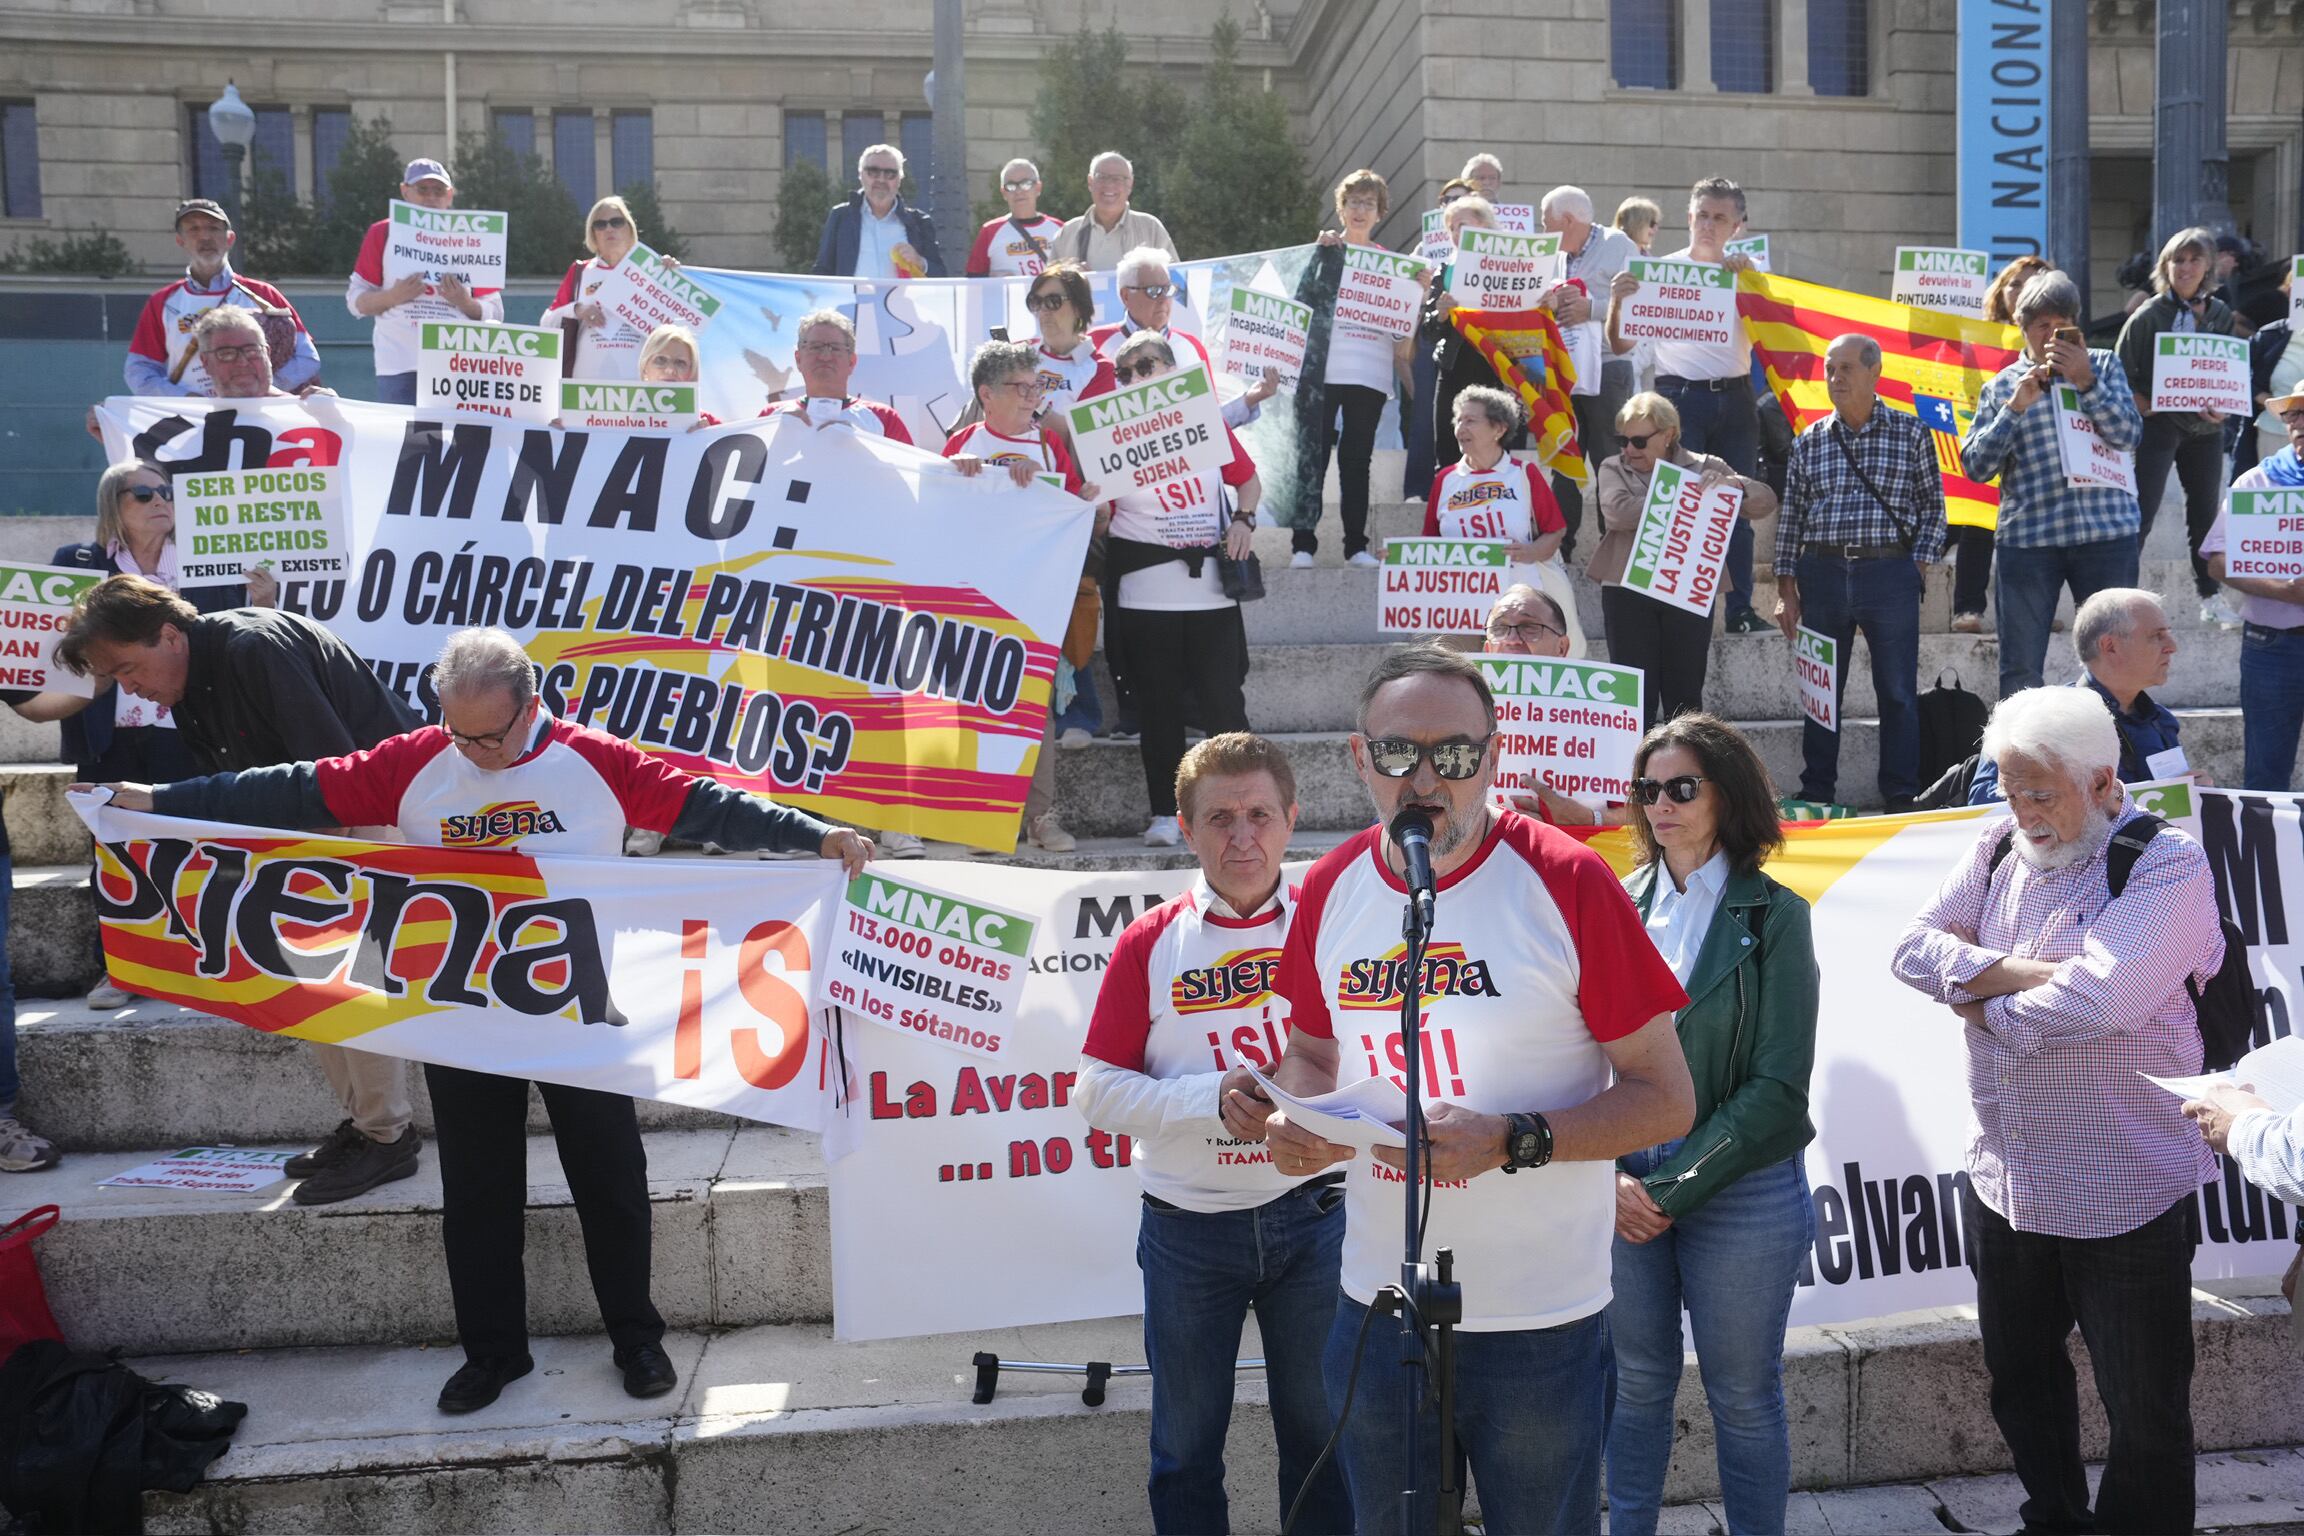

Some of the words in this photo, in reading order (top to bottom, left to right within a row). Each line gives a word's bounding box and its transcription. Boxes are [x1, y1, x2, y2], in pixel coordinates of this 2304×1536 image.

[409, 209, 489, 233] MNAC
[416, 231, 464, 248] devuelve
[467, 235, 481, 248] las
[1472, 233, 1548, 257] MNAC
[394, 245, 449, 265] PINTURAS
[452, 254, 501, 266] MURALES
[1344, 248, 1414, 279] MNAC
[1480, 256, 1534, 273] devuelve
[1914, 252, 1978, 274] MNAC
[640, 254, 709, 308] MNAC
[1352, 272, 1392, 290] PIERDE
[1464, 273, 1479, 287] LO
[1483, 275, 1508, 291] QUE
[1512, 277, 1525, 290] ES
[1528, 276, 1543, 289] DE
[1643, 263, 1720, 287] MNAC
[1918, 274, 1960, 287] devuelve
[1961, 276, 1972, 289] las
[624, 266, 647, 287] LOS
[645, 284, 702, 327] RECURSOS
[630, 293, 648, 309] NO
[1481, 293, 1522, 308] SIJENA
[1659, 286, 1701, 301] PIERDE
[1897, 293, 1947, 306] PINTURAS
[1949, 294, 1983, 309] MURALES
[1244, 292, 1306, 331] MNAC
[1404, 301, 1411, 313] Y
[1632, 304, 1714, 321] CREDIBILIDAD
[1717, 311, 1725, 323] Y
[1230, 312, 1286, 340] incapacidad
[1624, 323, 1728, 343] RECONOCIMIENTO
[438, 326, 539, 357] MNAC
[1229, 338, 1250, 353] para
[1253, 342, 1262, 355] el
[2174, 338, 2240, 360] MNAC
[450, 353, 523, 378] devuelve
[1226, 360, 1243, 374] por
[1245, 362, 1260, 377] tus
[2191, 359, 2228, 373] PIERDE
[432, 377, 450, 397] LO
[456, 379, 489, 401] QUE
[495, 381, 514, 400] ES
[520, 384, 541, 403] DE
[2164, 378, 2240, 392] CREDIBILIDAD
[579, 386, 677, 413] MNAC
[1089, 377, 1192, 429] MNAC
[2157, 396, 2249, 412] RECONOCIMIENTO
[1112, 410, 1184, 445] devuelve
[2071, 417, 2091, 432] LOS
[1100, 453, 1122, 474] LO
[1126, 440, 1161, 467] QUE
[1162, 432, 1183, 453] ES
[1185, 423, 1209, 446] DE
[2091, 442, 2104, 457] NO
[1133, 455, 1191, 487] SIJENA
[2091, 463, 2127, 487] RAZONES
[186, 475, 236, 499] SER
[243, 471, 327, 495] POCOS
[386, 420, 811, 551] MNAC:
[195, 504, 230, 527] NO
[238, 500, 323, 524] RESTA
[1459, 505, 1507, 538] ¡SÍ!
[1634, 480, 1677, 571] MNAC
[1664, 481, 1703, 565] JUSTICIA
[1700, 492, 1738, 563] IGUALA
[192, 529, 329, 556] DERECHOS
[1400, 543, 1491, 566] MNAC
[2241, 539, 2304, 554] CREDIB
[281, 558, 342, 573] EXISTE
[1387, 571, 1409, 593] LA
[1415, 571, 1500, 595] JUSTICIA
[1655, 567, 1681, 595] LA
[1687, 563, 1718, 608] NOS
[0, 610, 68, 632] URSO
[357, 548, 397, 623] O
[402, 540, 595, 630] CÁRCEL
[596, 563, 694, 638] DEL
[696, 573, 1026, 714] PATRIMONIO
[1385, 607, 1422, 629] NOS
[1427, 607, 1491, 630] IGUAL
[0, 640, 40, 658] AN
[1796, 630, 1824, 661] AC
[1482, 662, 1617, 702] MNAC
[576, 664, 853, 793] PUEBLOS?
[1528, 702, 1544, 722] la
[1549, 709, 1638, 732] sentencia
[1563, 736, 1595, 760] del
[1543, 769, 1632, 798] Supremo
[2199, 793, 2304, 946] M
[866, 879, 1009, 949] MNAC
[849, 910, 933, 959] 113.000
[938, 945, 1012, 982] obras
[841, 948, 1003, 1014] «INVISIBLES»
[829, 979, 855, 1001] en
[861, 989, 894, 1021] los
[899, 1008, 1001, 1053] sótanos
[1360, 1012, 1466, 1098] ¡SÍ!
[869, 1070, 938, 1120] La
[950, 1066, 1078, 1117] Avar
[1008, 1135, 1073, 1178] no
[1799, 1161, 1971, 1288] elvan
